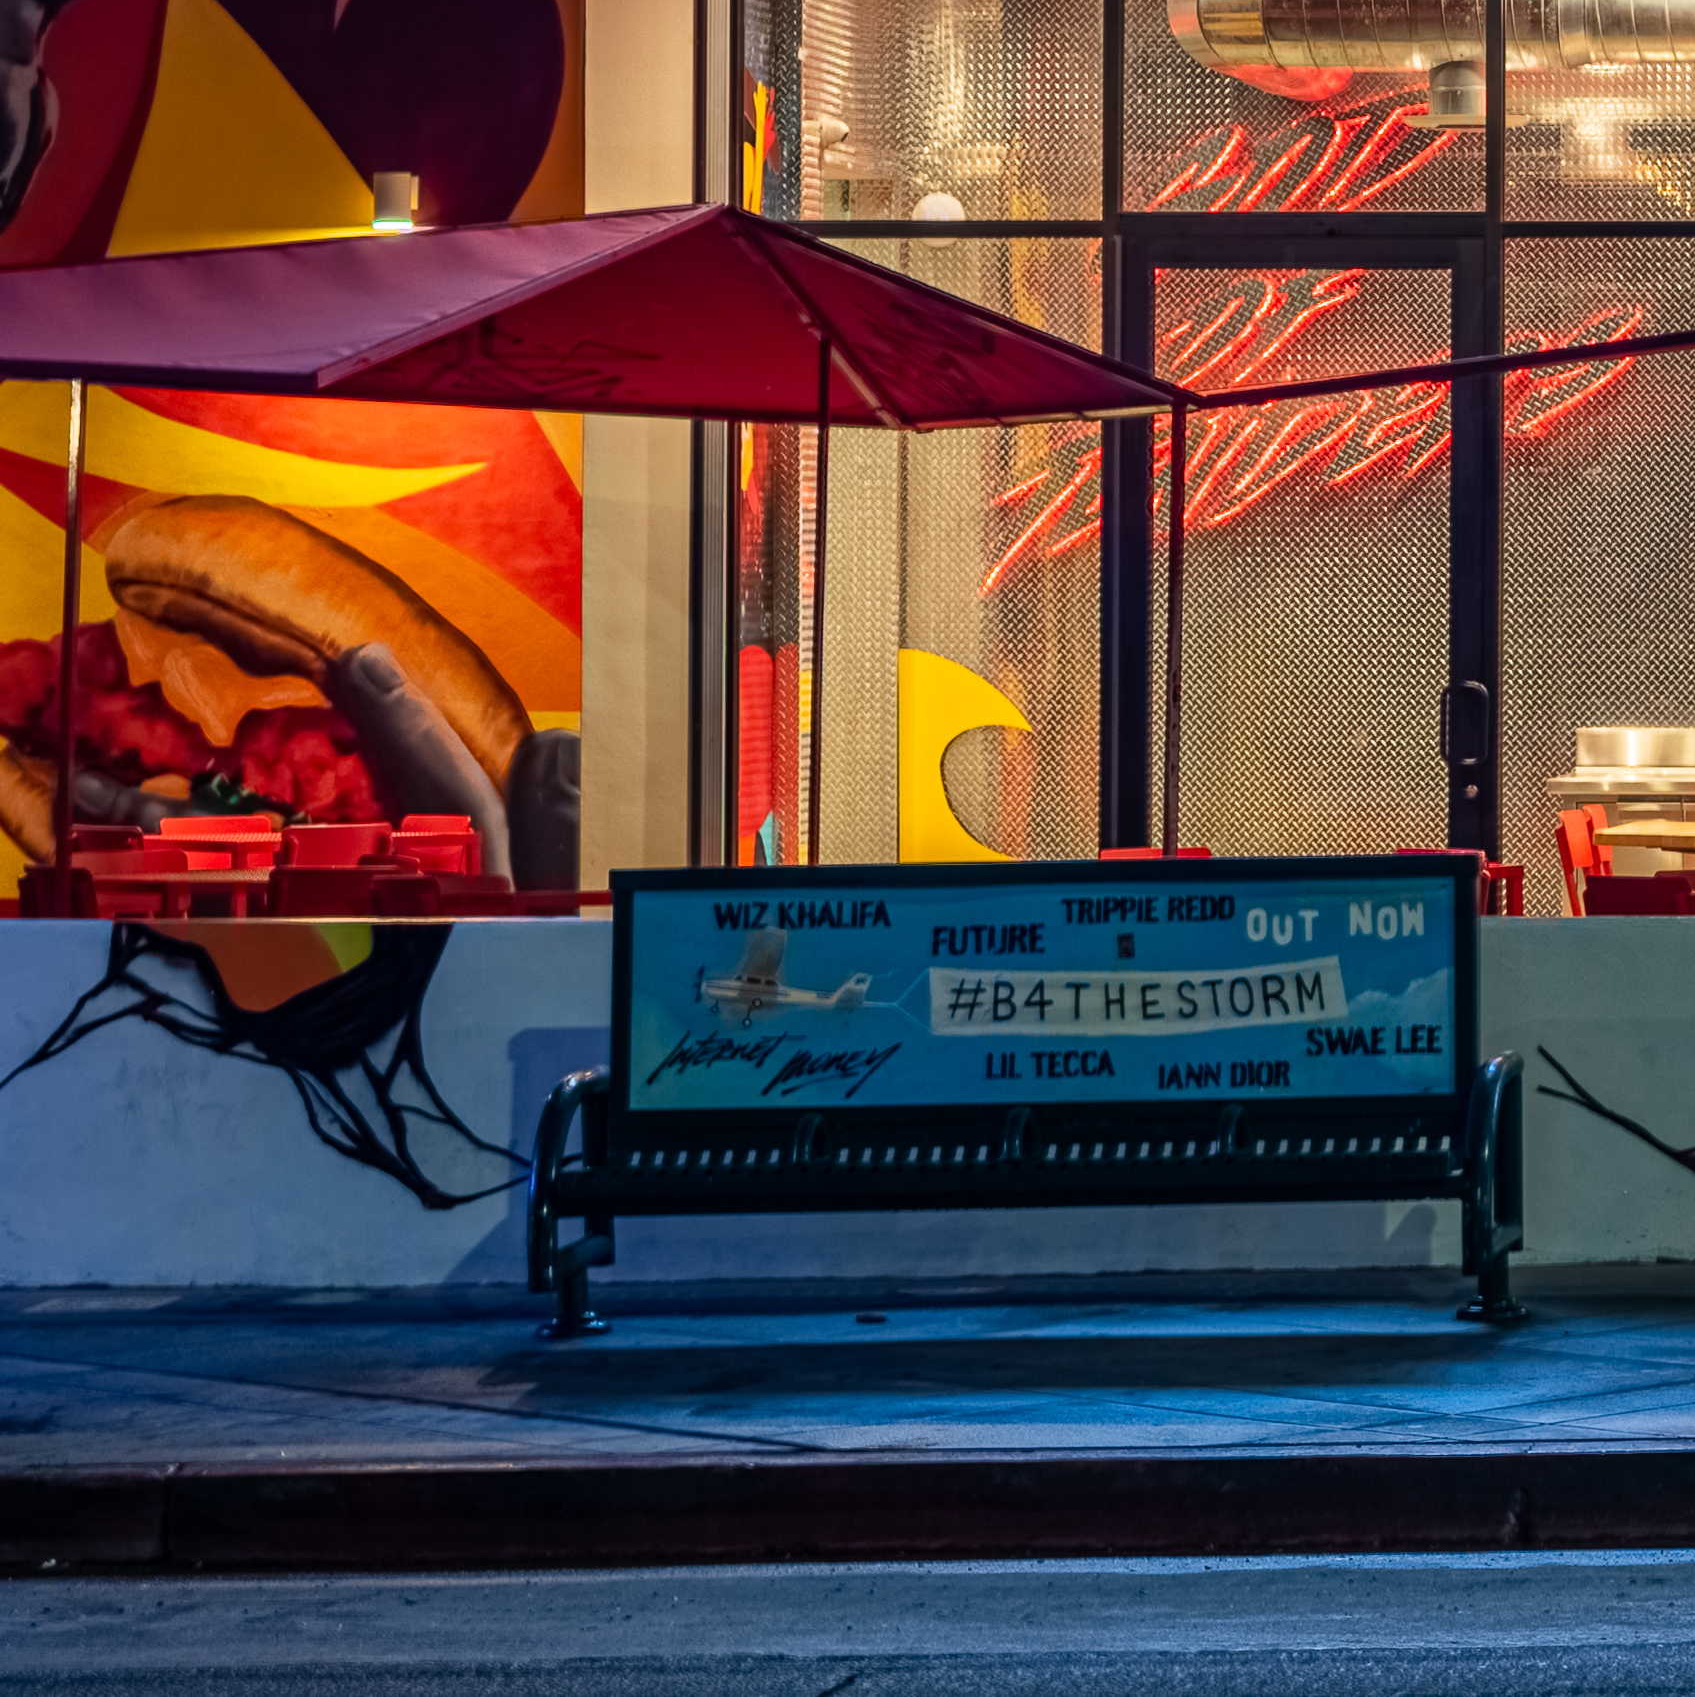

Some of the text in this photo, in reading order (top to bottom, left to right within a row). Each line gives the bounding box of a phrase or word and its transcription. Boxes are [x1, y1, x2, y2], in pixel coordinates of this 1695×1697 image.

[713, 900, 891, 929] WIZ KHALIFA
[1061, 894, 1235, 924] TRIPPIE REDD
[1246, 901, 1424, 946] OUT NOW
[932, 923, 1045, 956] FUTURE
[947, 970, 1328, 1023] #B4THESTORM
[1306, 1024, 1442, 1056] SWAE LEE
[986, 1050, 1115, 1079] LIL TECCA
[1159, 1060, 1291, 1090] IANN DIOR
